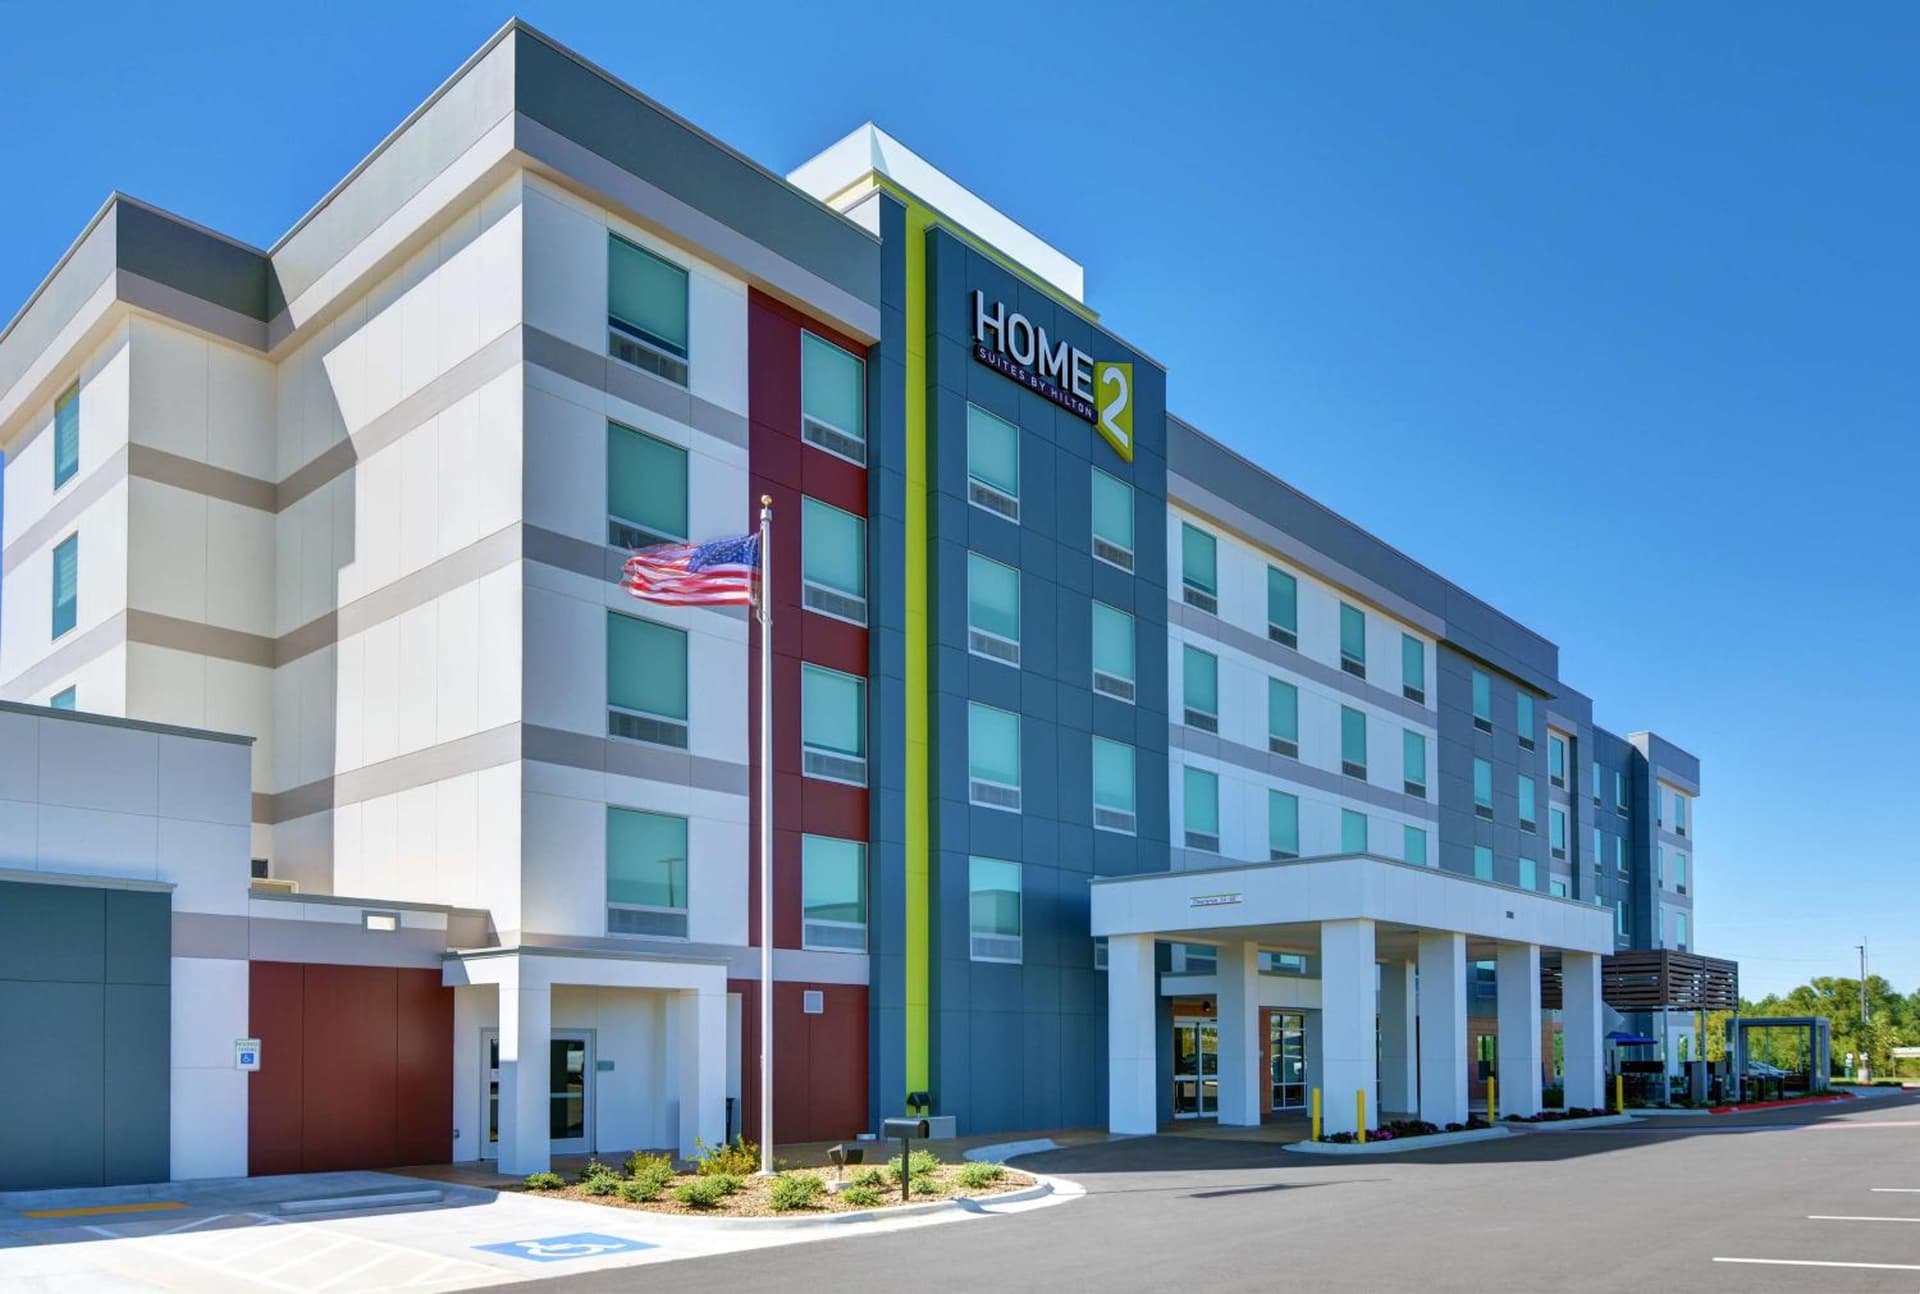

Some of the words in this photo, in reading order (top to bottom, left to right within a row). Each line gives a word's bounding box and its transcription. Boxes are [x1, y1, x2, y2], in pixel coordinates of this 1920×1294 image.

[975, 289, 1094, 403] HOME
[1102, 366, 1128, 448] 2
[979, 347, 1025, 380] SUITES
[1031, 376, 1046, 391] BY
[1051, 387, 1092, 417] HILTON
